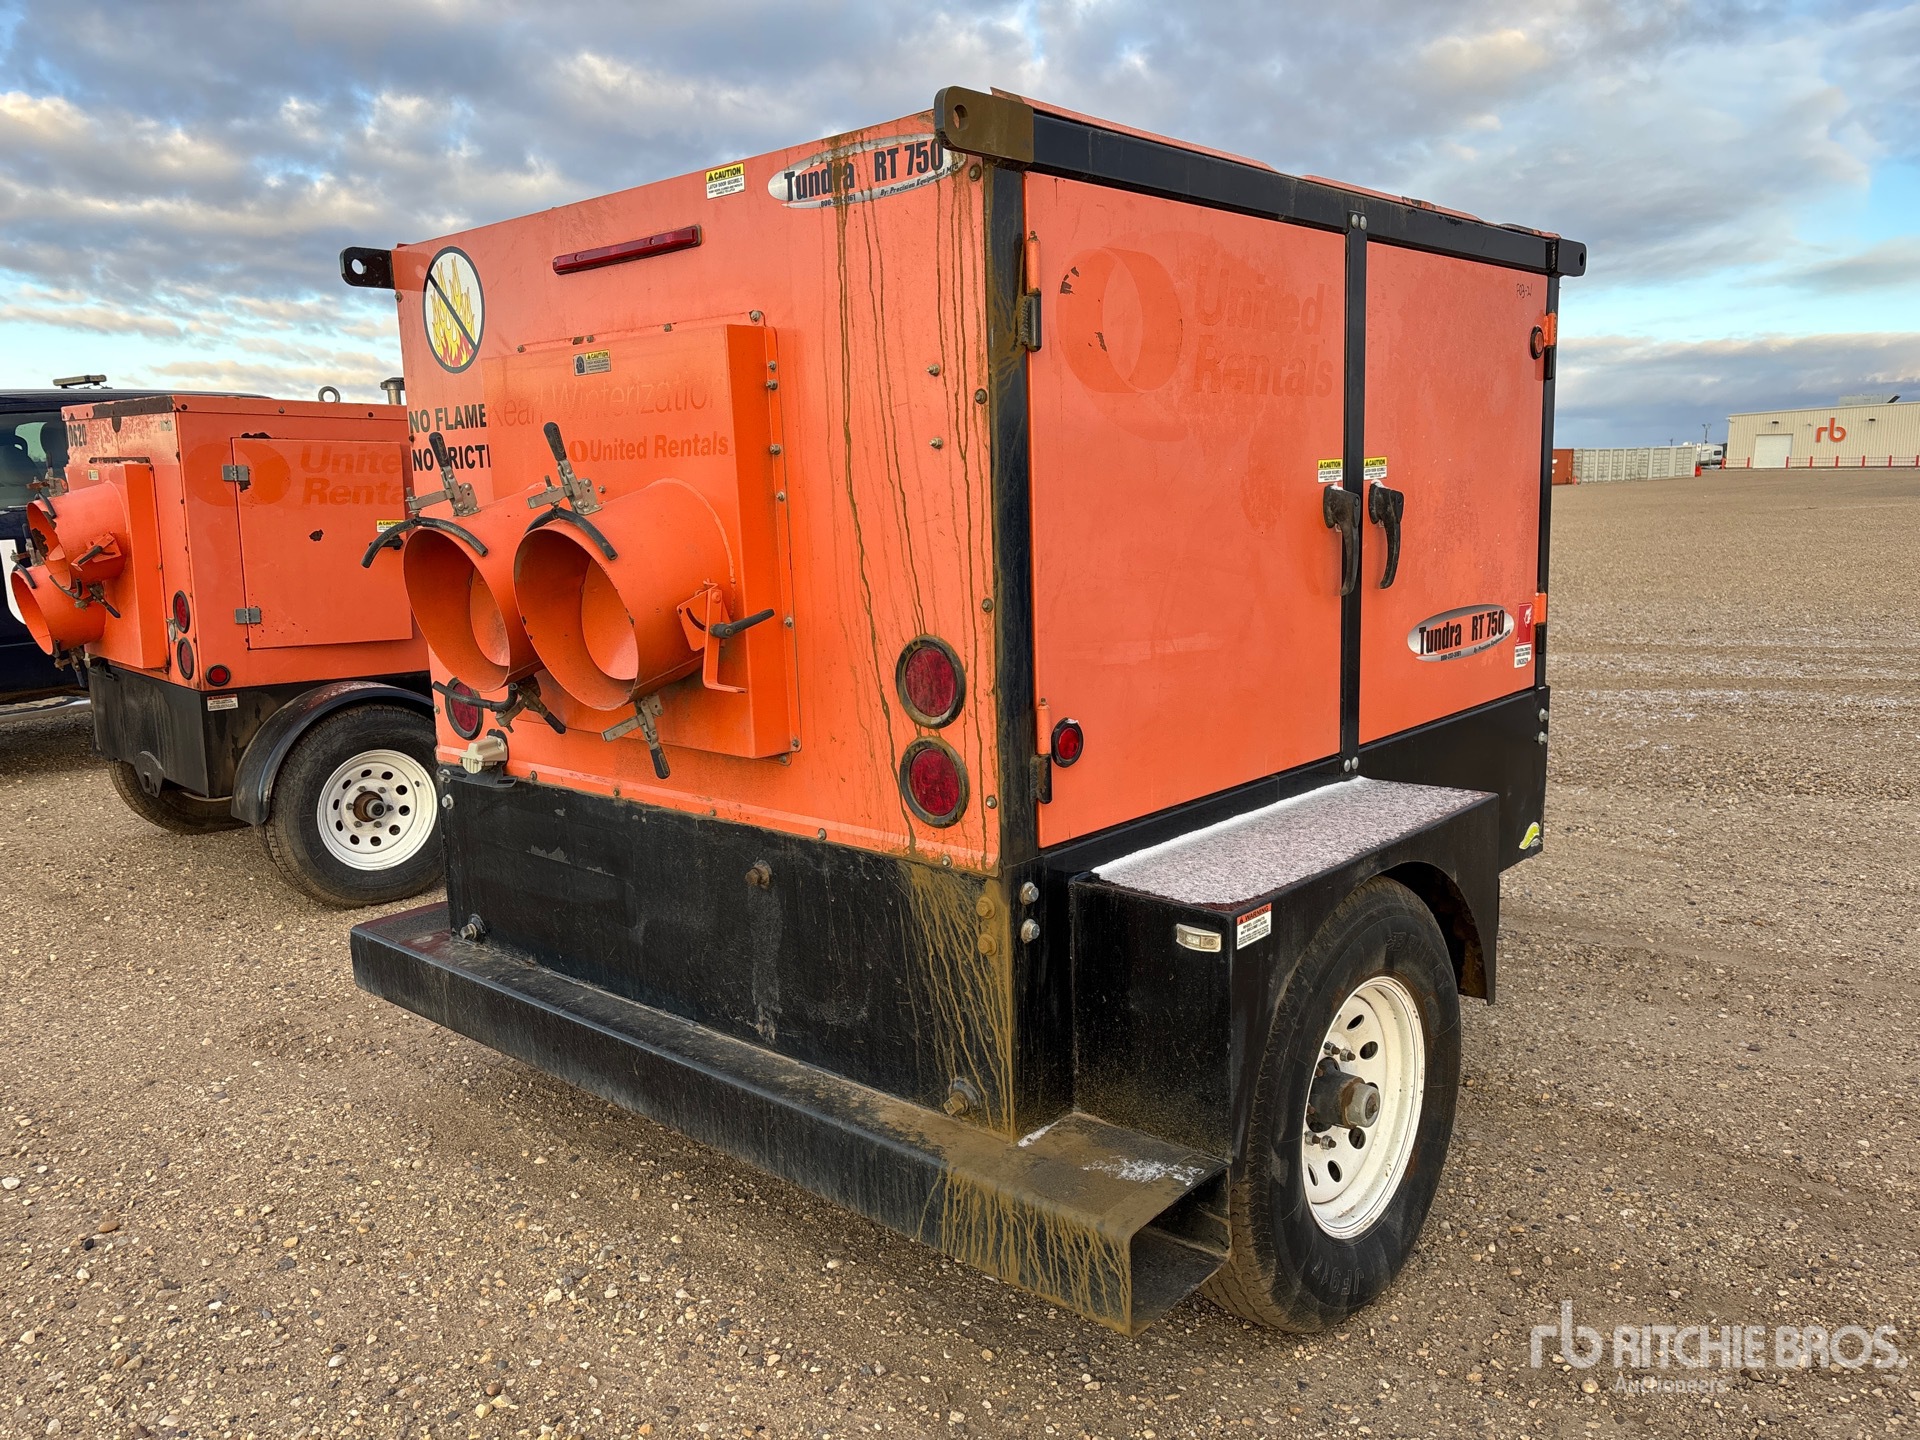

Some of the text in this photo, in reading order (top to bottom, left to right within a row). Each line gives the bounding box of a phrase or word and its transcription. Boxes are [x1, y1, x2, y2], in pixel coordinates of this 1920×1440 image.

[714, 166, 742, 180] CAUTION
[873, 148, 899, 182] RT
[904, 138, 944, 177] 750
[1194, 265, 1326, 336] United
[1193, 334, 1334, 398] Rentals
[408, 408, 431, 434] NO
[1815, 417, 1847, 443] rb
[412, 447, 434, 471] NO
[590, 430, 729, 463] United Rentals
[1324, 461, 1341, 469] CAUTION
[1369, 459, 1386, 467] CAUTION
[1419, 621, 1462, 655] Tundra
[1471, 614, 1485, 641] RT
[1487, 609, 1505, 637] 750
[1244, 905, 1269, 921] WARNING
